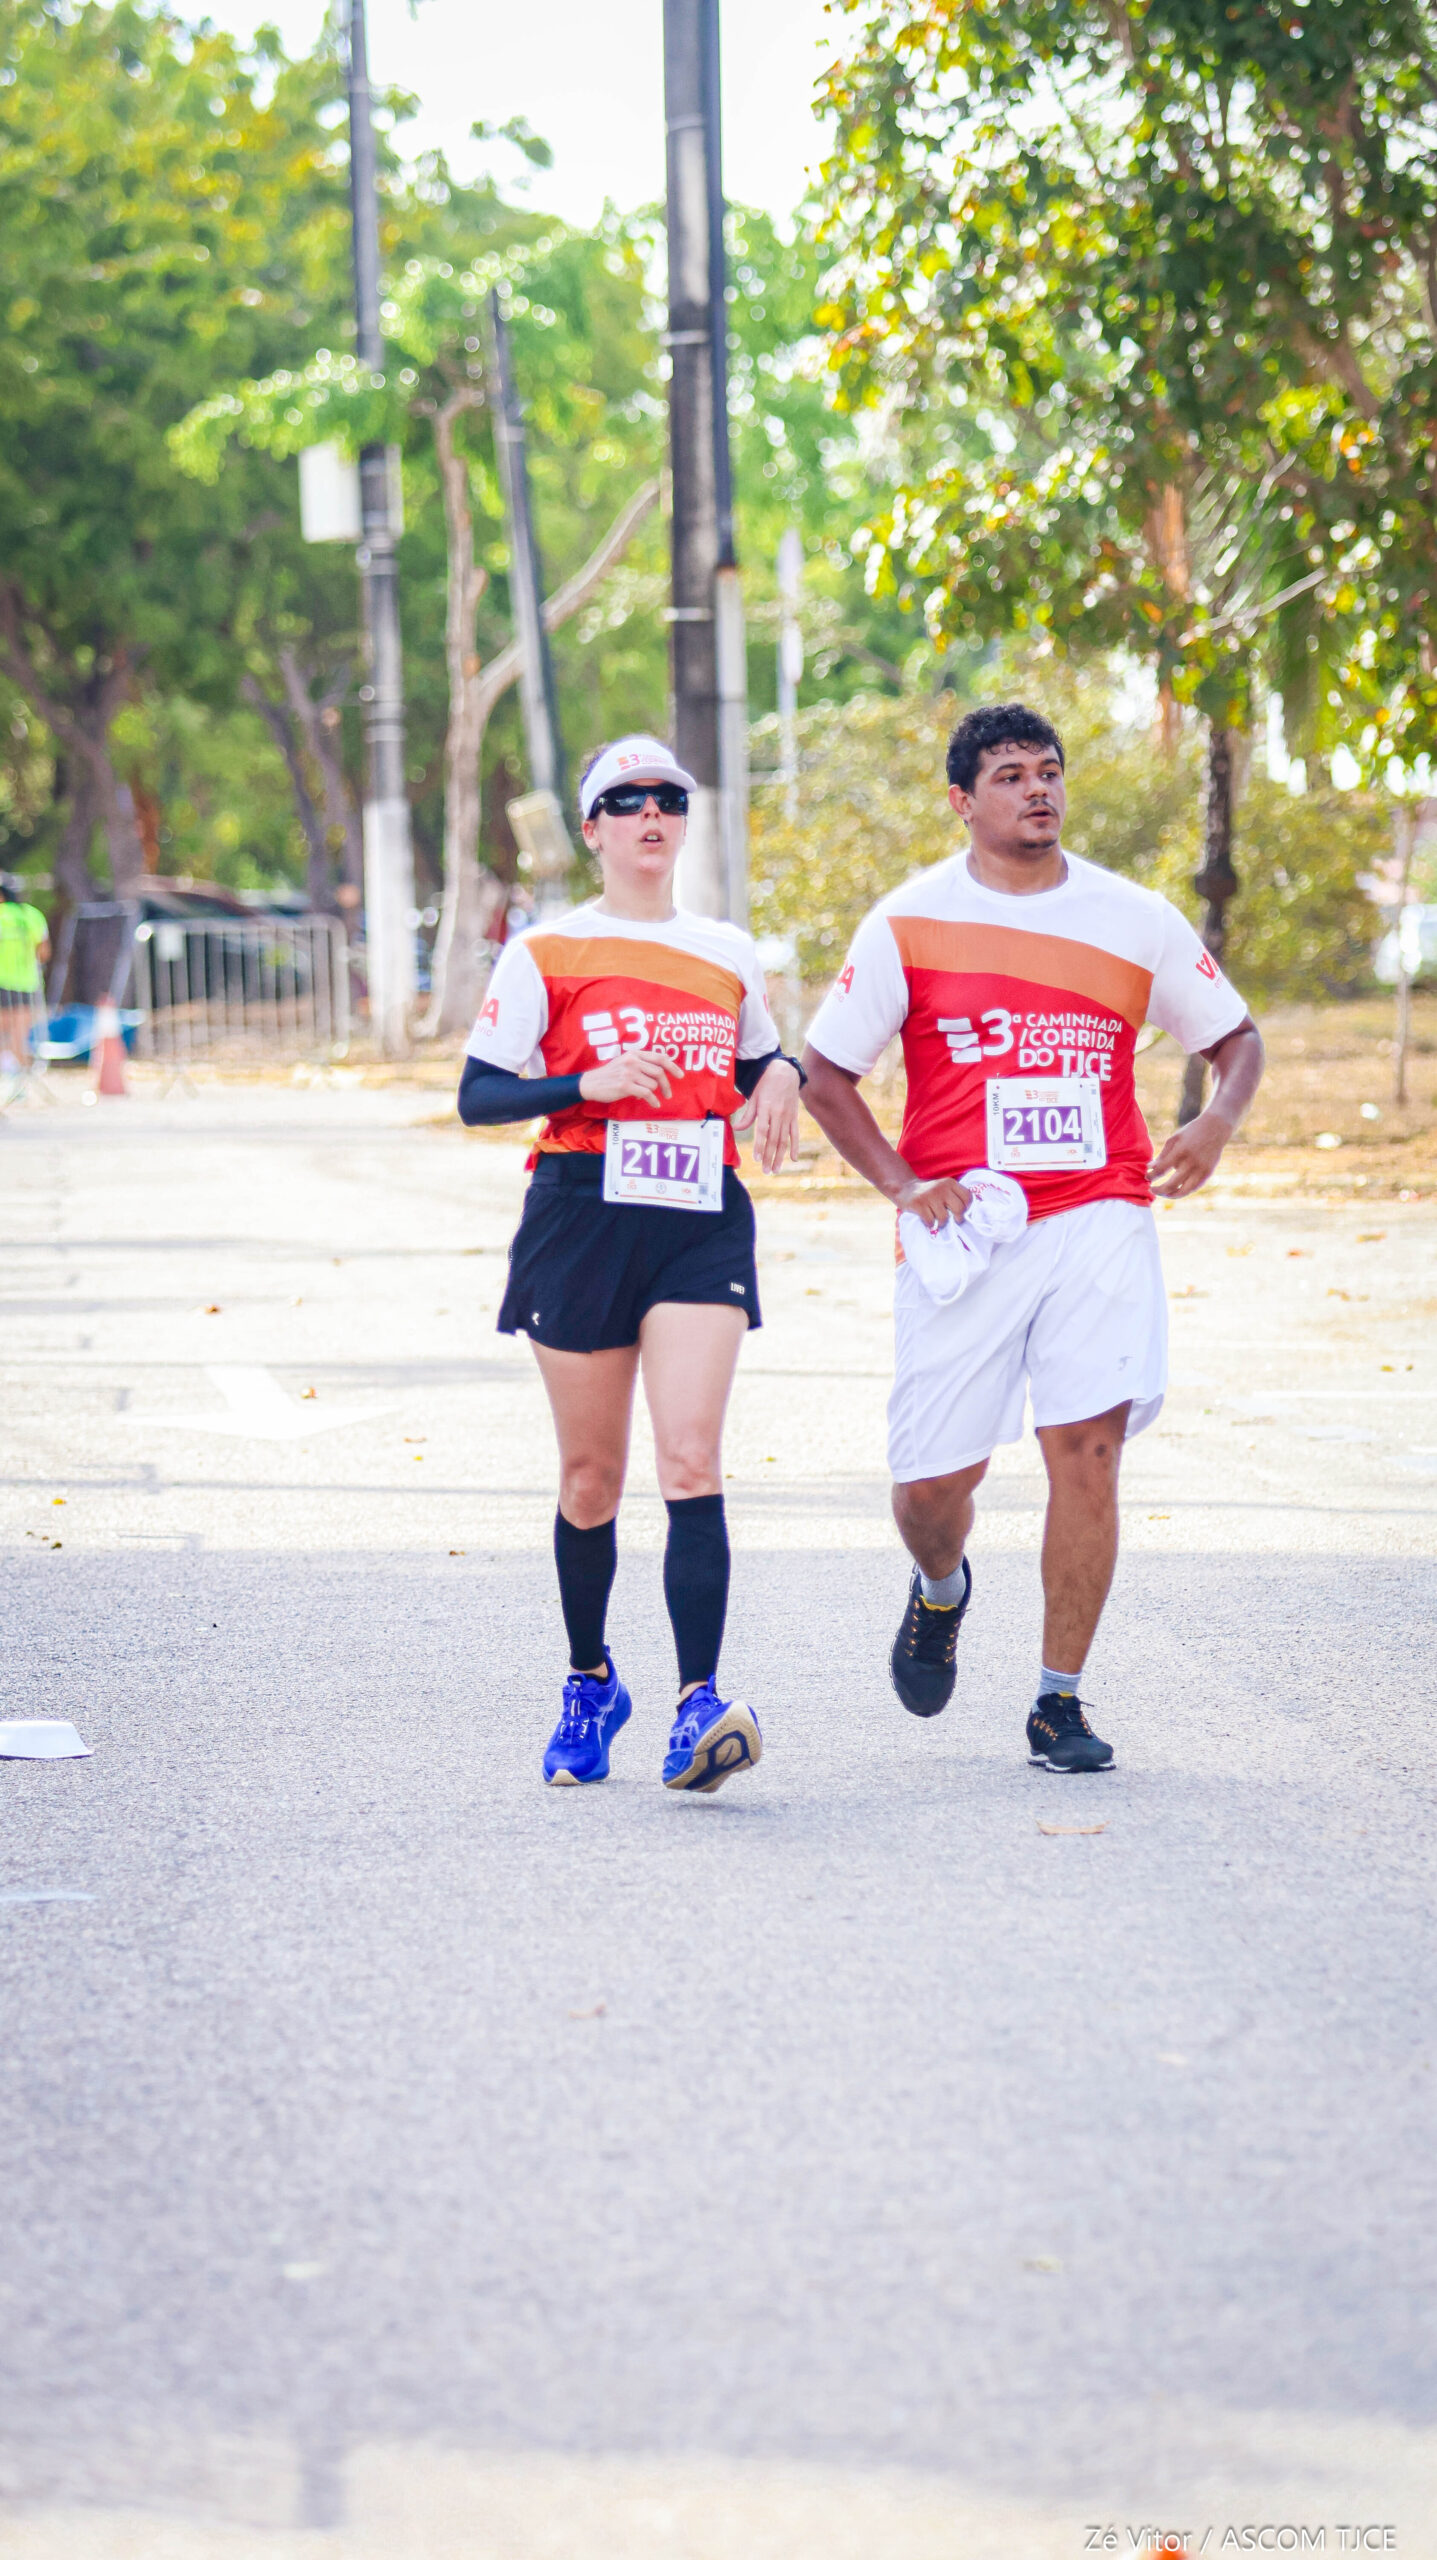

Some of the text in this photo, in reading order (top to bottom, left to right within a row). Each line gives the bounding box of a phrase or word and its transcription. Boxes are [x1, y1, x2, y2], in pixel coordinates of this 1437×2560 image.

[657, 1012, 736, 1031] CAMINHADA
[1026, 1013, 1122, 1033] CAMINHADA
[682, 1044, 732, 1077] TJCE
[1019, 1048, 1112, 1082] DO TJCE
[1005, 1109, 1081, 1142] 2104
[623, 1142, 699, 1180] 2117
